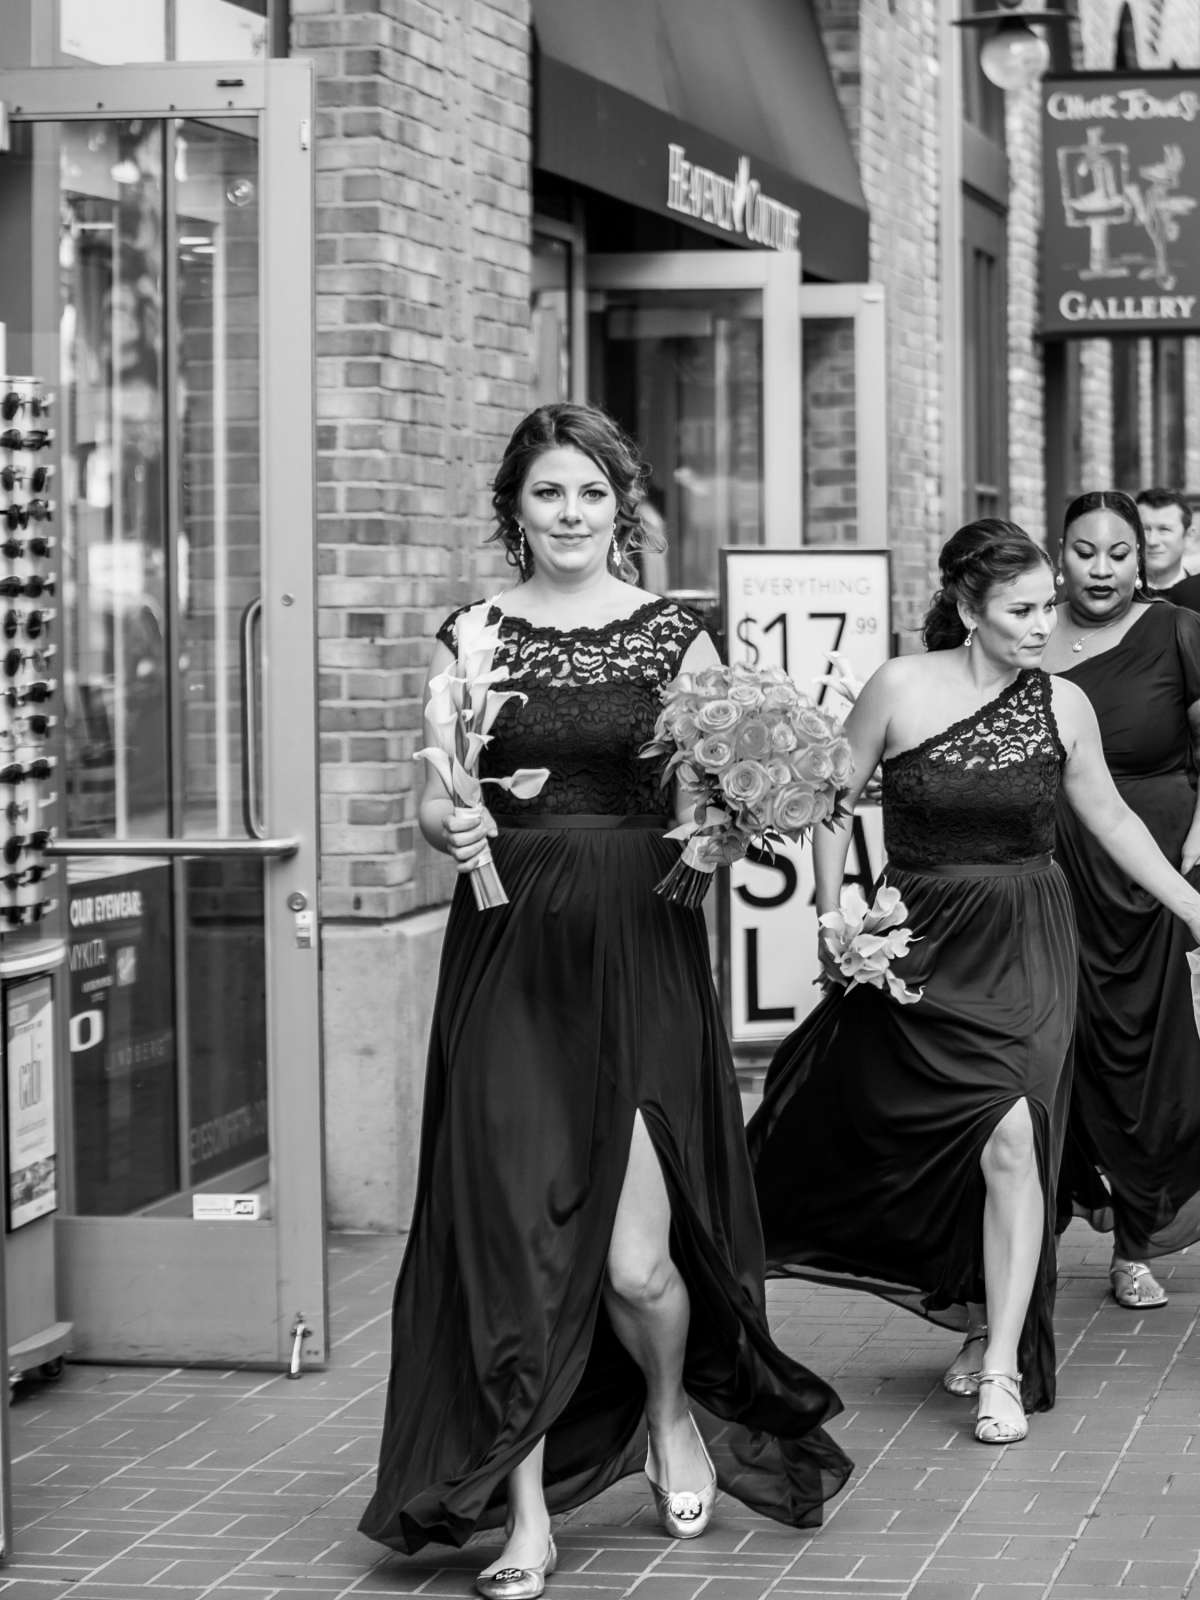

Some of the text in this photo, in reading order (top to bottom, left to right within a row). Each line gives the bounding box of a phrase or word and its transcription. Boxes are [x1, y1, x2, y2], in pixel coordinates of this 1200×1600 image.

[1059, 290, 1196, 321] GALLERY
[743, 577, 871, 596] EVERYTHING
[70, 890, 143, 928] OUR EYEWEAR
